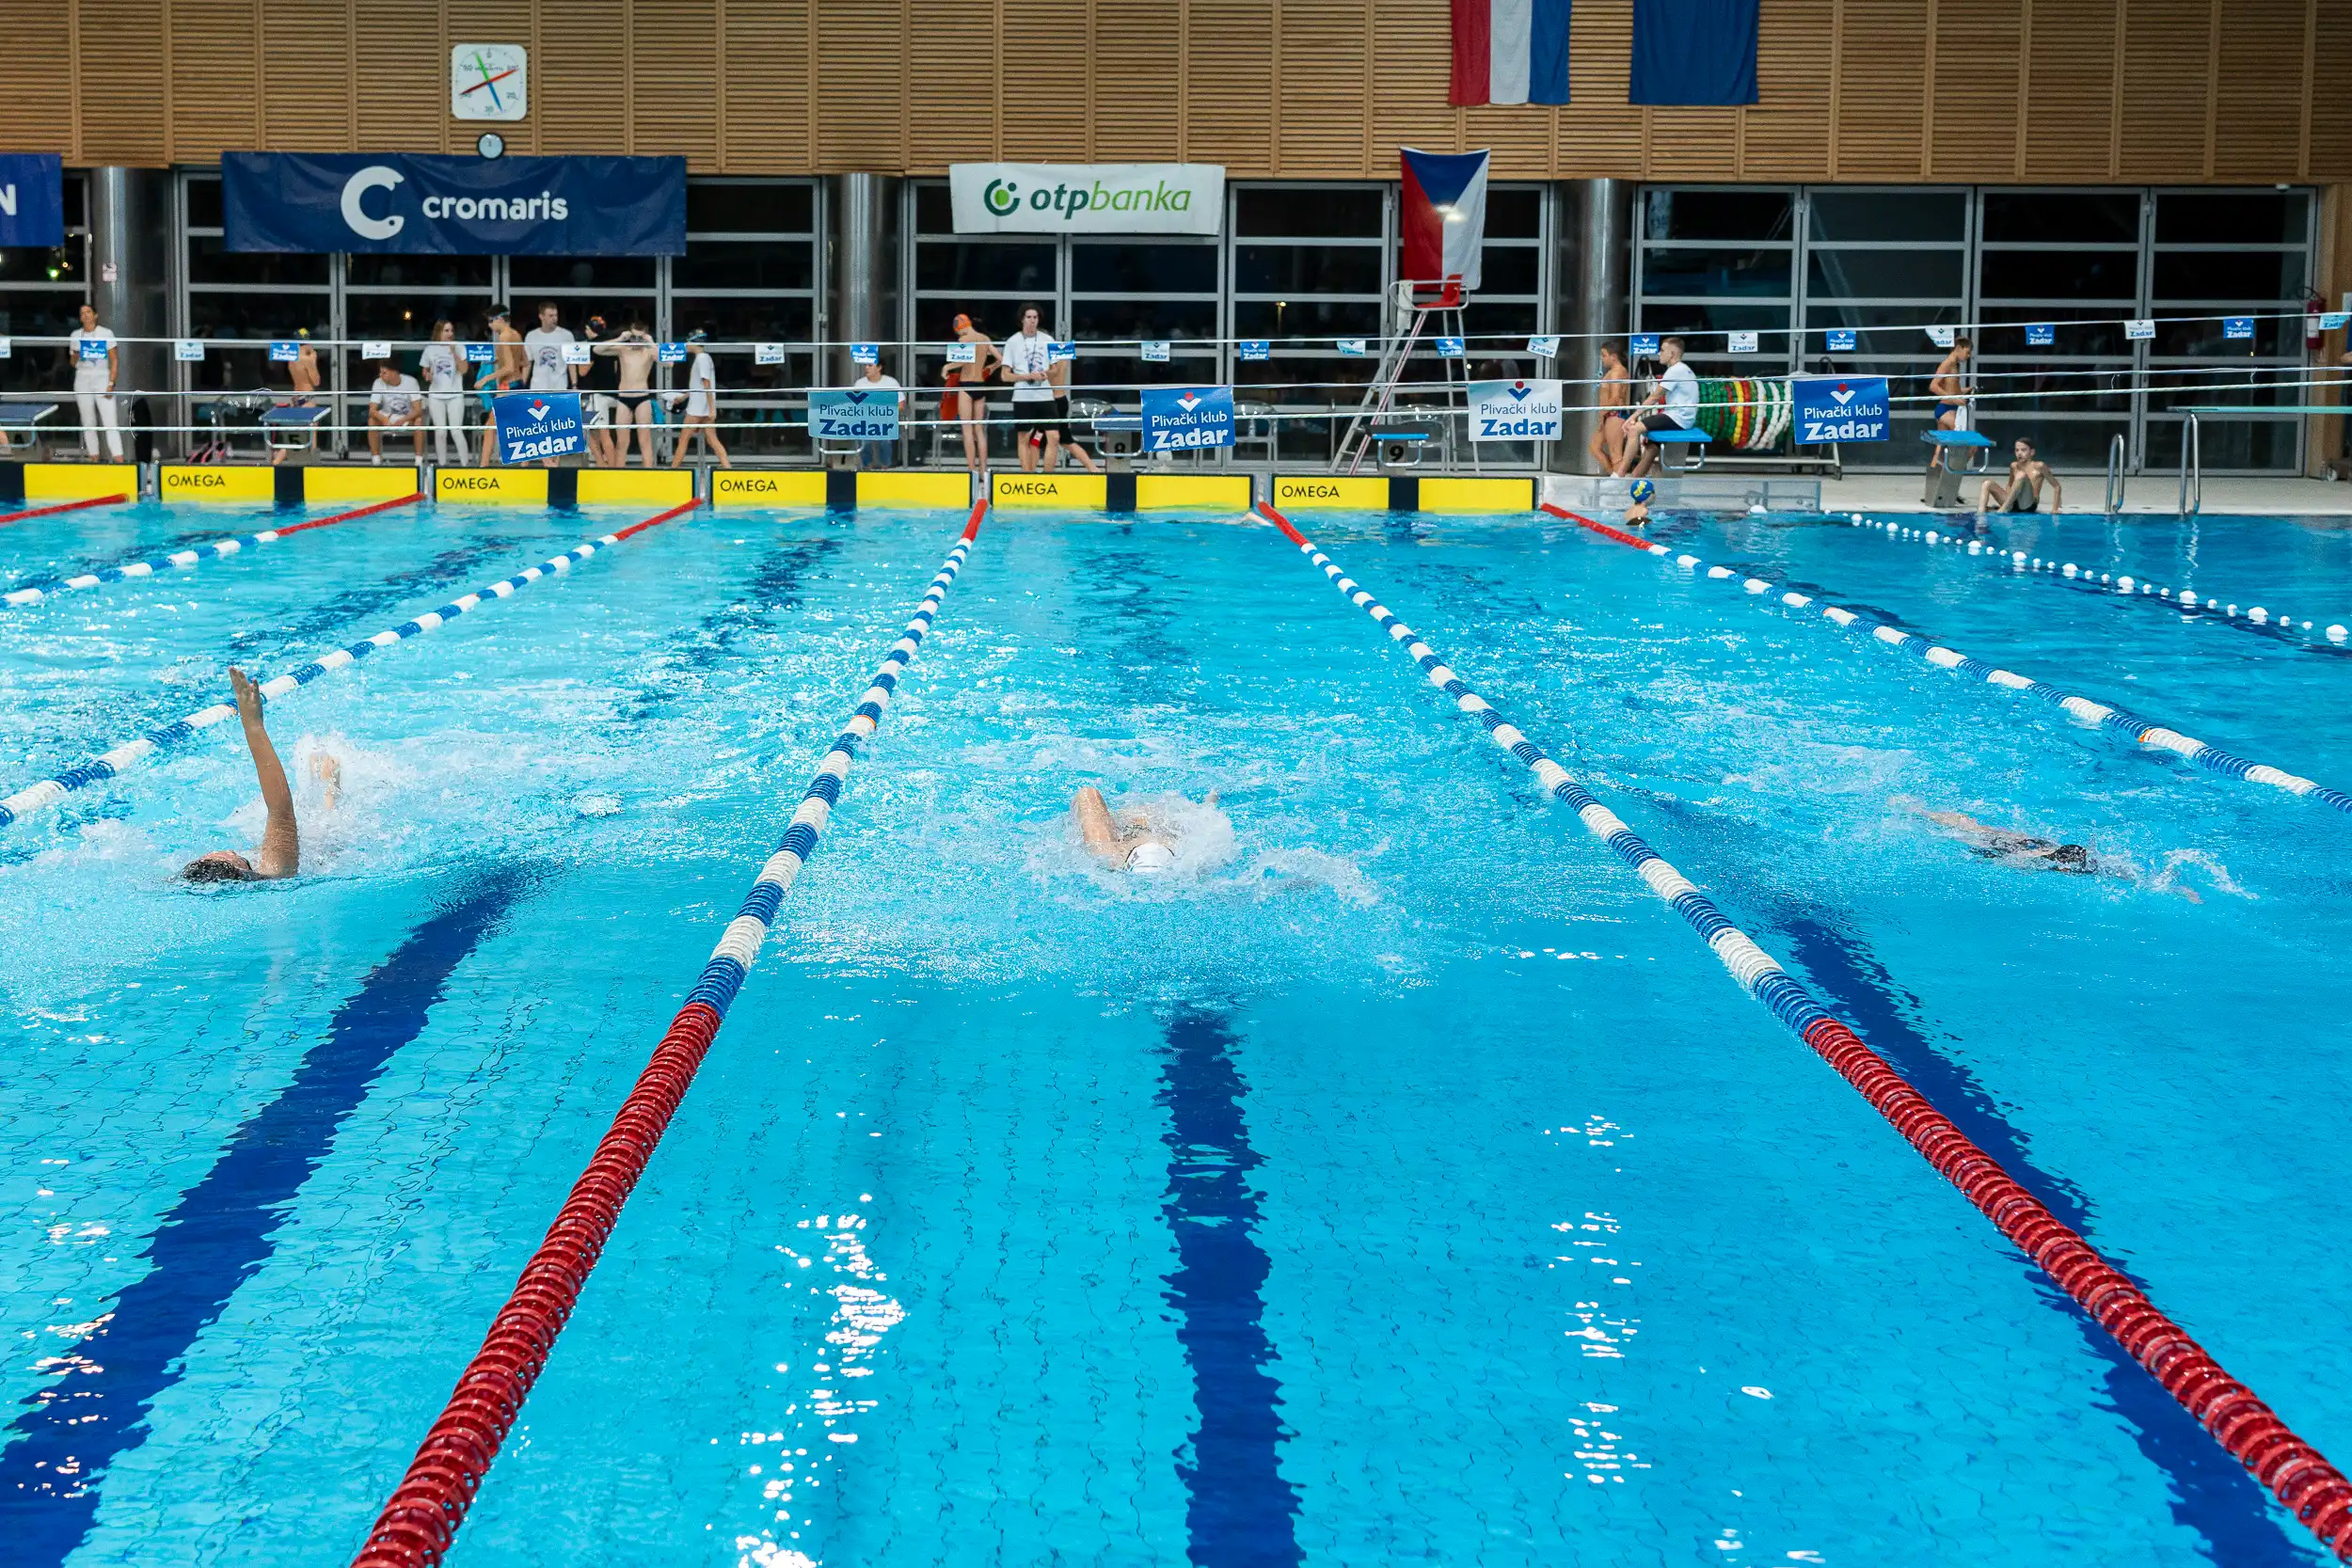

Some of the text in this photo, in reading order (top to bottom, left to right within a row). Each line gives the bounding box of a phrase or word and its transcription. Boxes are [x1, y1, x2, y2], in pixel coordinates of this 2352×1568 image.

[421, 191, 569, 220] cromaris
[819, 404, 894, 417] Plivački klub
[1481, 403, 1557, 416] Plivački klub
[1804, 404, 1883, 420] Plivački klub
[1152, 410, 1228, 427] Plivački klub
[506, 419, 576, 439] Plivački klub
[818, 419, 894, 436] Zadar
[1480, 418, 1557, 437] Zadar
[1804, 420, 1883, 441] Zadar
[1152, 428, 1229, 450] Zadar
[508, 435, 578, 461] Zadar
[1389, 445, 1404, 462] 9
[167, 474, 226, 487] OMEGA
[442, 477, 501, 489] OMEGA
[720, 479, 778, 492] OMEGA
[1000, 483, 1058, 495] OMEGA
[1281, 485, 1340, 498] OMEGA
